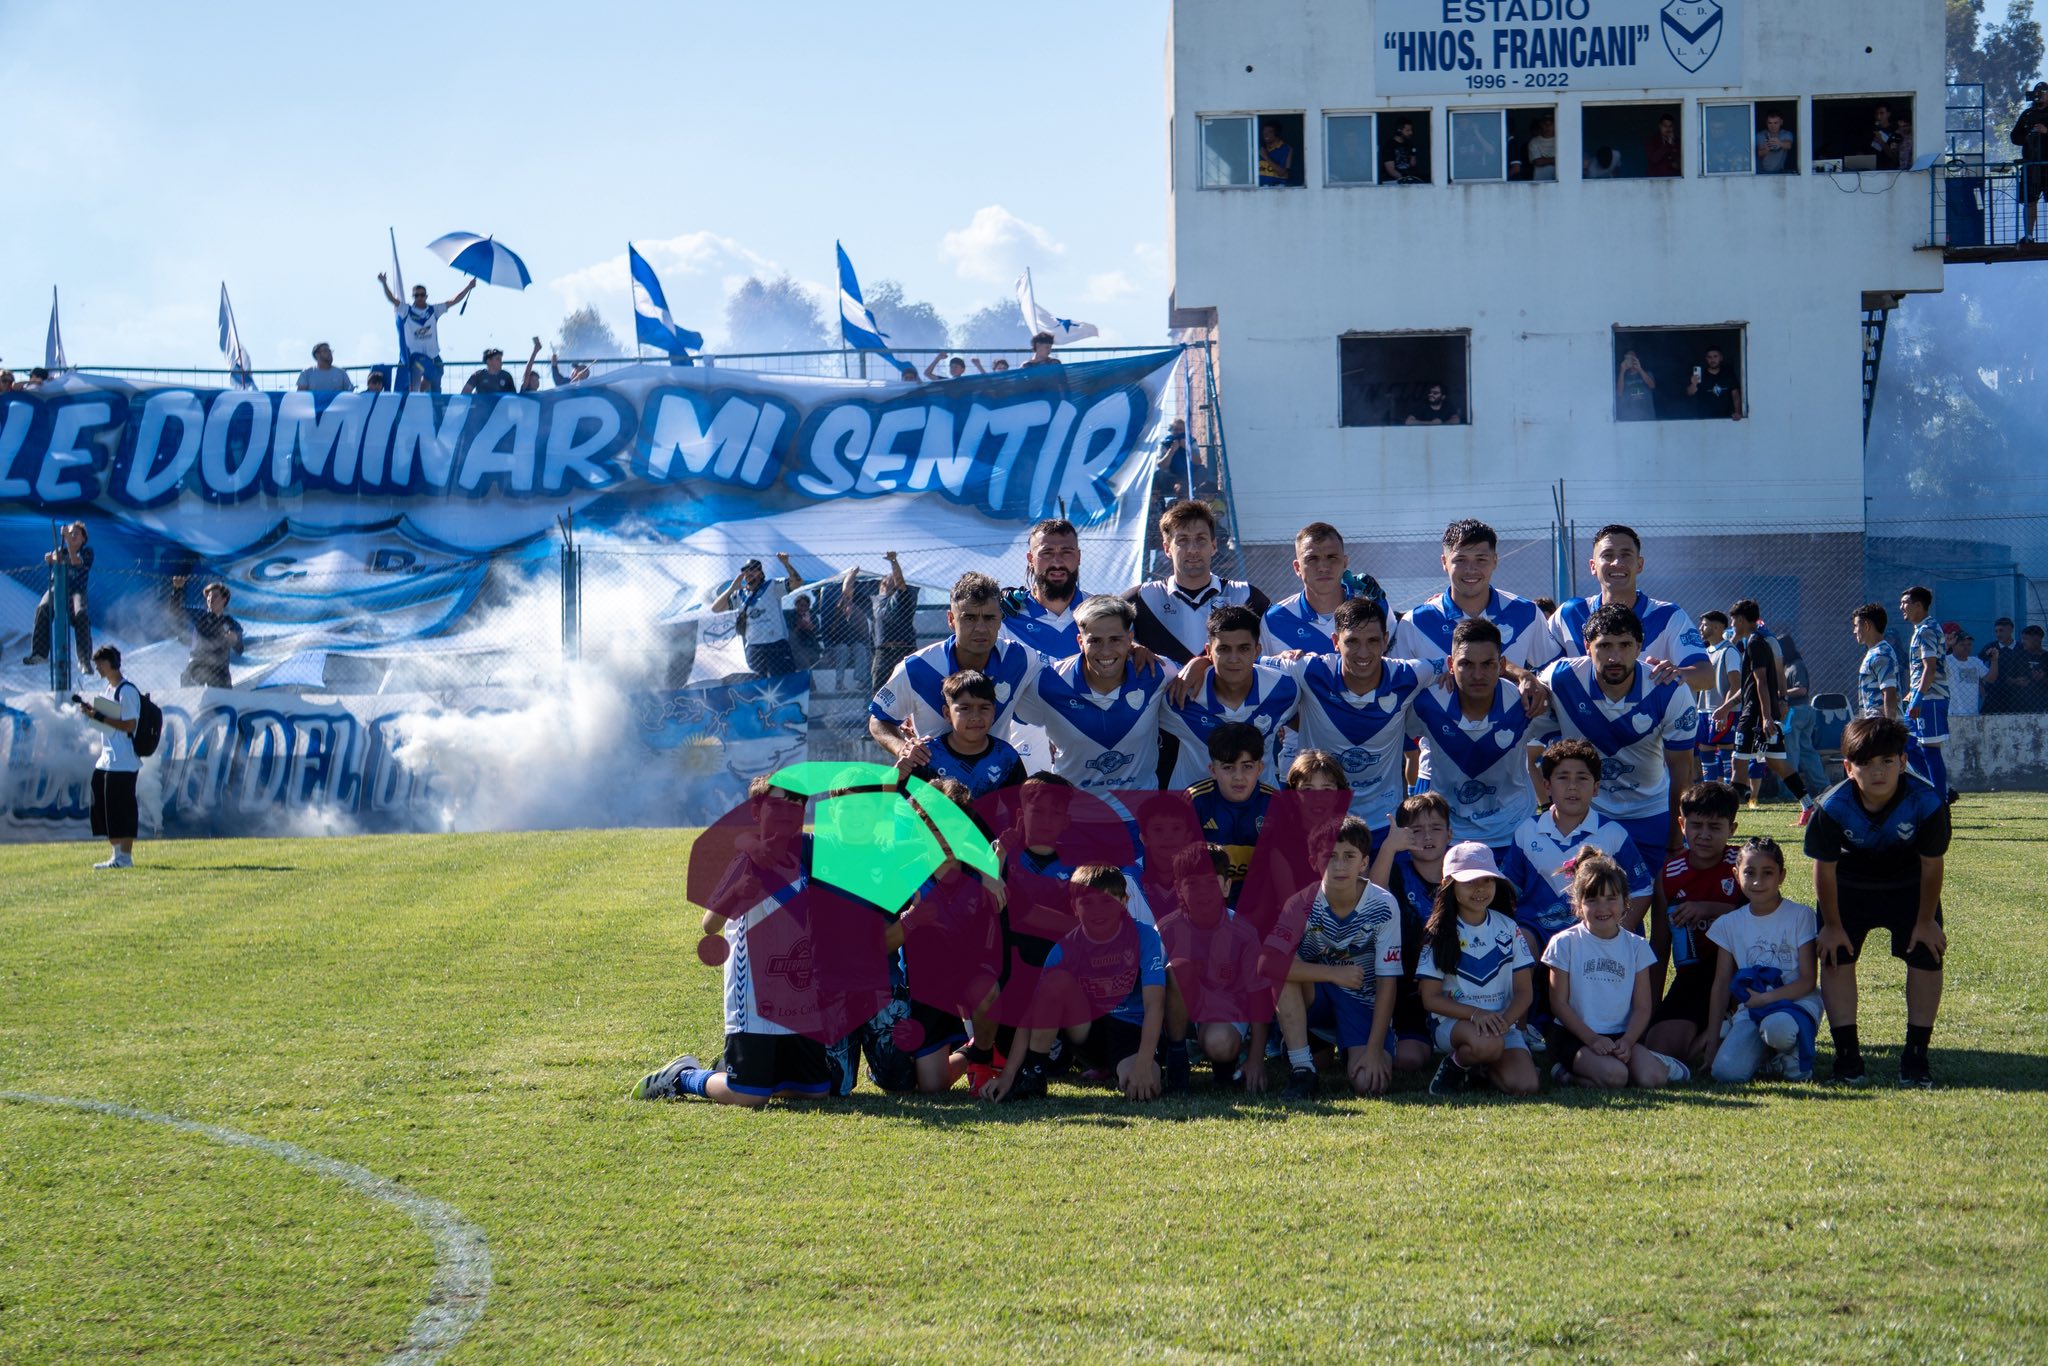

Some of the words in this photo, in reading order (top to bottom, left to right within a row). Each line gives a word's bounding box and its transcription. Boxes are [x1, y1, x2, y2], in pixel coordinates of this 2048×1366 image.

[1442, 0, 1590, 24] ESTADIO
[1465, 74, 1507, 89] 1996
[1524, 73, 1569, 88] 2022
[126, 390, 622, 501] DOMINAR
[646, 394, 786, 484] MI
[799, 391, 1131, 514] SENTIR
